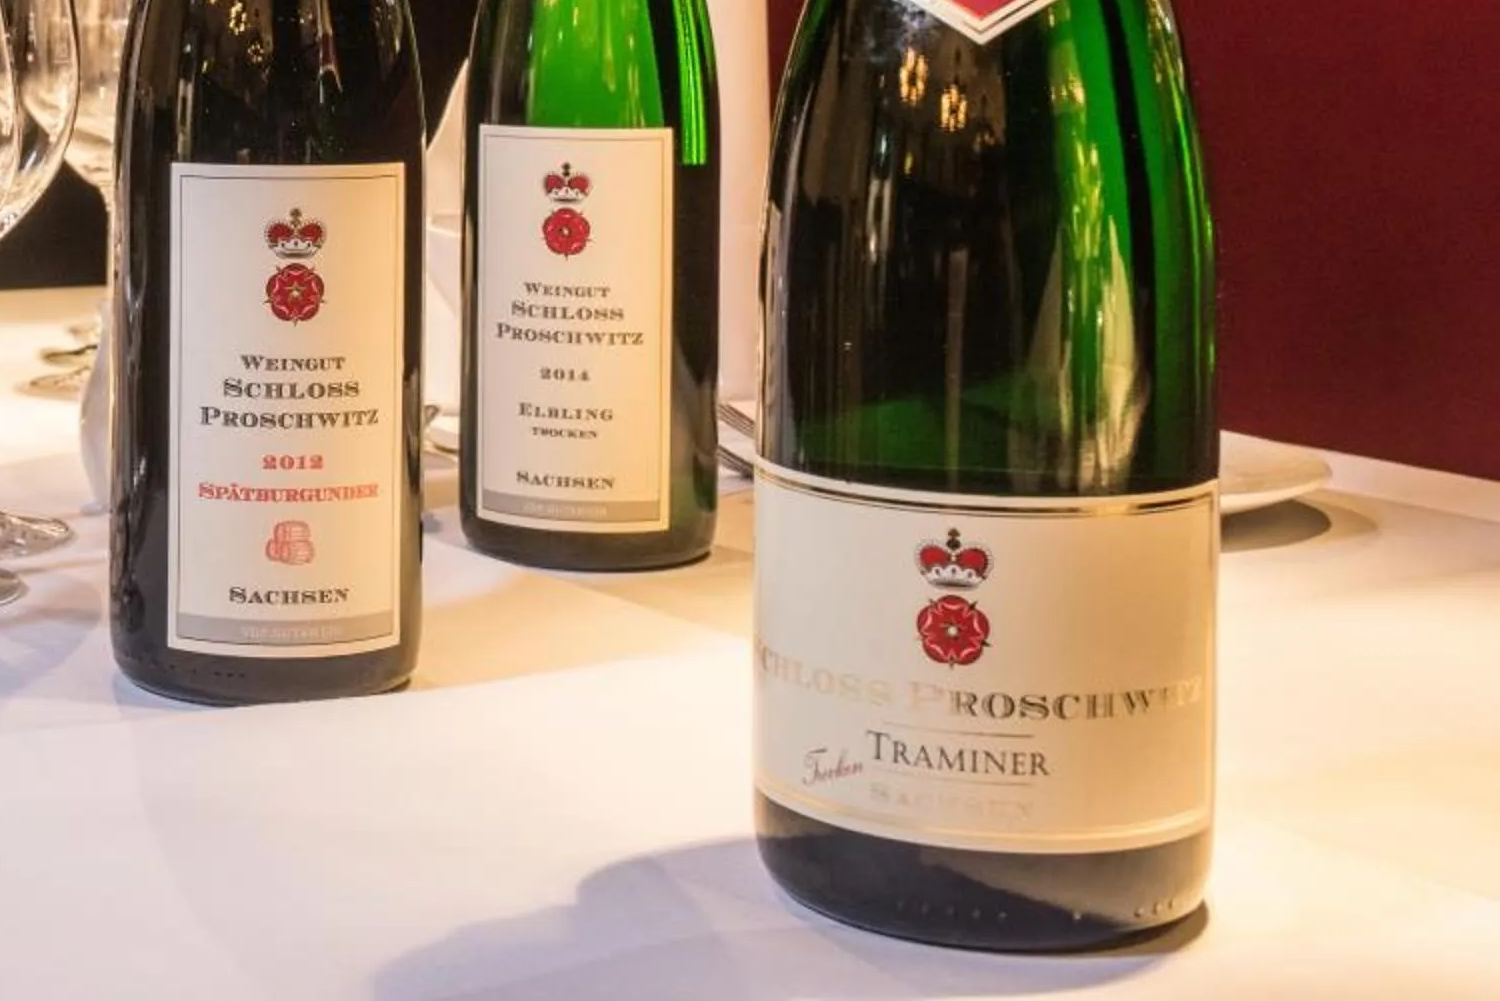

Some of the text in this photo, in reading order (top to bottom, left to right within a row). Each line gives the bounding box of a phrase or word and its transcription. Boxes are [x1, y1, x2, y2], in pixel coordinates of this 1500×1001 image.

[524, 282, 611, 298] WEINGUT
[511, 300, 625, 321] SCHLOSS
[496, 322, 644, 346] PROSCHWITZ
[240, 354, 346, 372] WEINGUT
[540, 367, 590, 381] 2014
[223, 377, 360, 399] SCHLOSS
[200, 406, 379, 429] PROSCHWITZ
[518, 402, 614, 421] ELBLING
[262, 455, 324, 470] 2012
[516, 470, 616, 490] SACHSEN
[229, 586, 350, 605] SACHSEN
[866, 729, 1049, 776] TRAMINER
